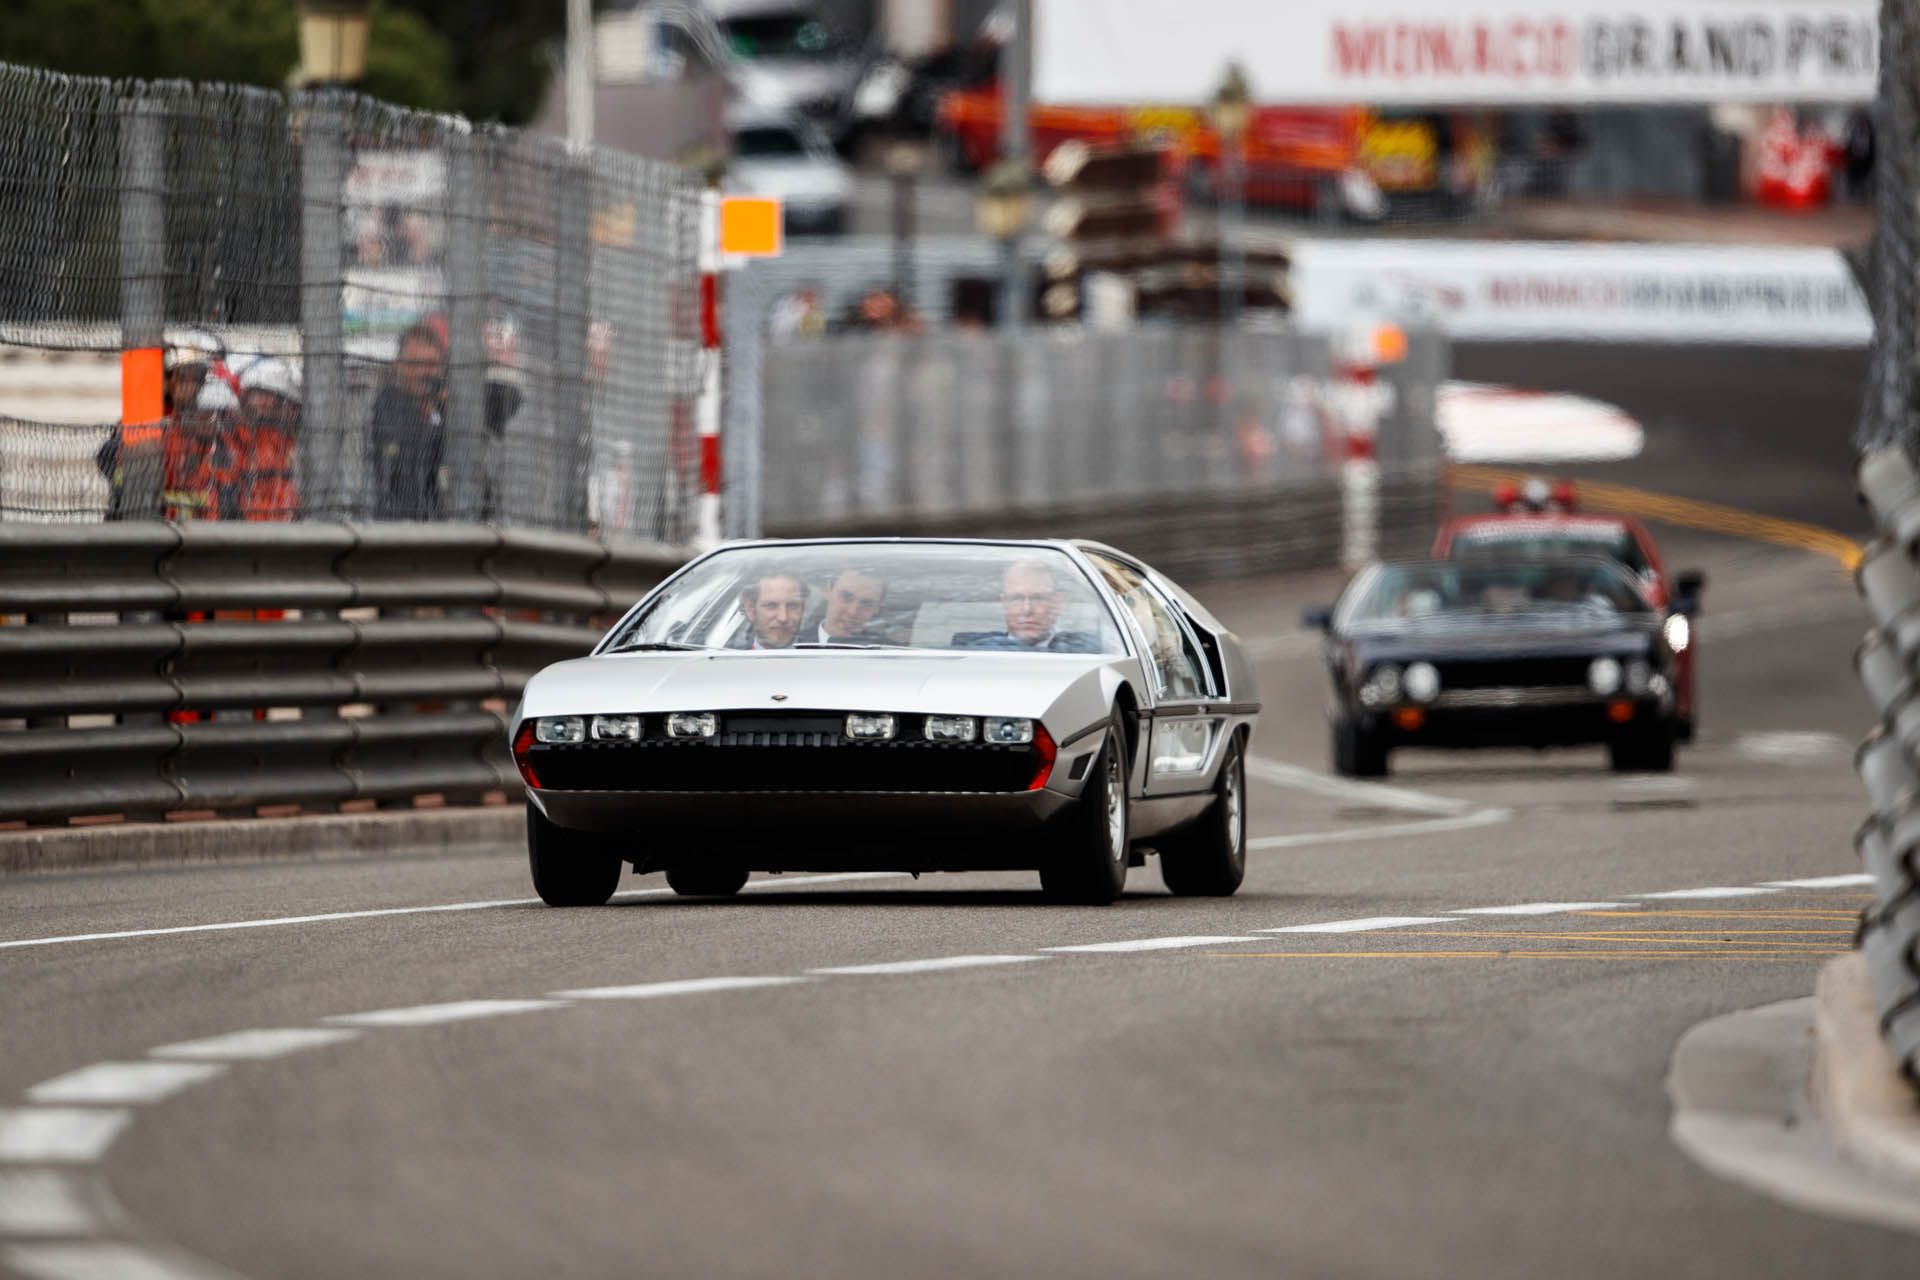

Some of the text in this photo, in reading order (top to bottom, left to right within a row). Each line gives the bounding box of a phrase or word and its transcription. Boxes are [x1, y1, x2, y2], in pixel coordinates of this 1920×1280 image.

[1331, 17, 1876, 78] MONACO GRAND PRI
